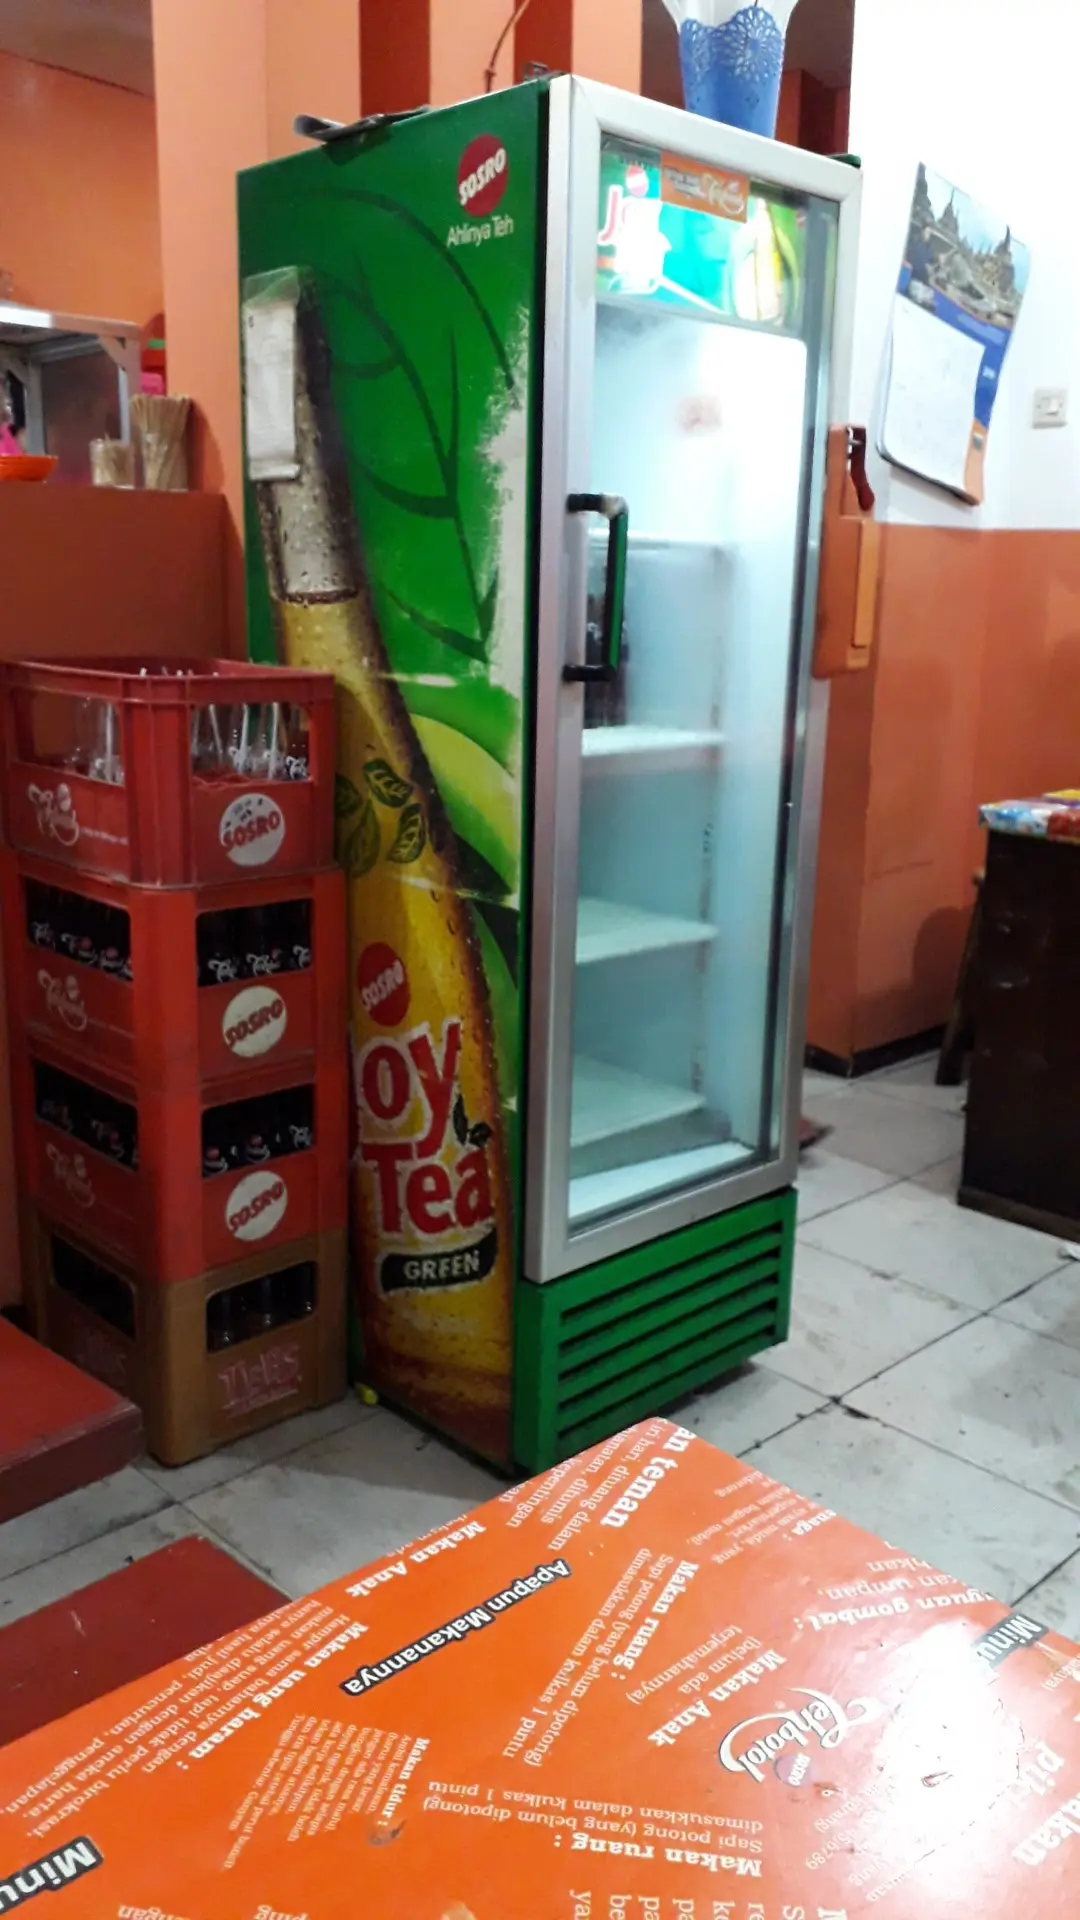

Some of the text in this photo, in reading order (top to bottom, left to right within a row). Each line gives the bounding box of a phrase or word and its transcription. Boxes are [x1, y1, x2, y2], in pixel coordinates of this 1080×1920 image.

[459, 148, 506, 206] SOSRO
[446, 213, 514, 248] Ahlinya Teh
[222, 810, 281, 852] SOSRO
[362, 959, 404, 1012] SOSRO
[224, 1000, 285, 1048] SOSRO
[362, 1143, 493, 1235] Tea
[403, 1250, 480, 1282] GREEN
[601, 1457, 677, 1527] teman
[548, 1510, 591, 1551] dalam
[346, 1521, 485, 1597] Makan Anak
[599, 1548, 652, 1617] dimasukkan
[652, 1561, 699, 1614] Makan
[280, 1599, 321, 1629] hanya
[290, 1606, 333, 1639] makan
[346, 1560, 569, 1693] Apapun Makanannya
[808, 1595, 911, 1630] gombal
[215, 1629, 252, 1660] hasil
[241, 1629, 280, 1658] selalu
[253, 1639, 292, 1666] uang
[304, 1622, 368, 1668] Makan
[572, 1618, 604, 1657] dalam
[612, 1617, 660, 1670] ruang
[179, 1657, 241, 1703] disajikan
[216, 1665, 257, 1692] suap,
[524, 1554, 675, 1767] Sapi potong (yang belum dipotong)
[539, 1658, 578, 1704] kulkas
[142, 1614, 350, 1773] Hampir sama bahannya dengan
[252, 1670, 305, 1708] uang
[648, 1649, 787, 1746] Makan Anak
[678, 1671, 709, 1694] ada
[105, 1680, 183, 1736] pencurian,
[124, 1704, 178, 1745] dengan
[188, 1694, 220, 1718] tapi
[148, 1712, 190, 1747] tidak
[189, 1707, 260, 1759] haram
[502, 1716, 537, 1758] pintu
[75, 1745, 123, 1782] aneka
[106, 1744, 149, 1779] perlu
[399, 1737, 430, 1780] Makan
[381, 1783, 407, 1819] tidur
[428, 1781, 479, 1798] pintu
[503, 1791, 567, 1811] kulkas
[573, 1799, 634, 1818] dalam
[422, 1794, 765, 1854] Sapi potong (yang belum dipotong)
[640, 1808, 766, 1837] dimasukkan
[572, 1832, 654, 1859] ruang
[665, 1848, 763, 1878] Makan
